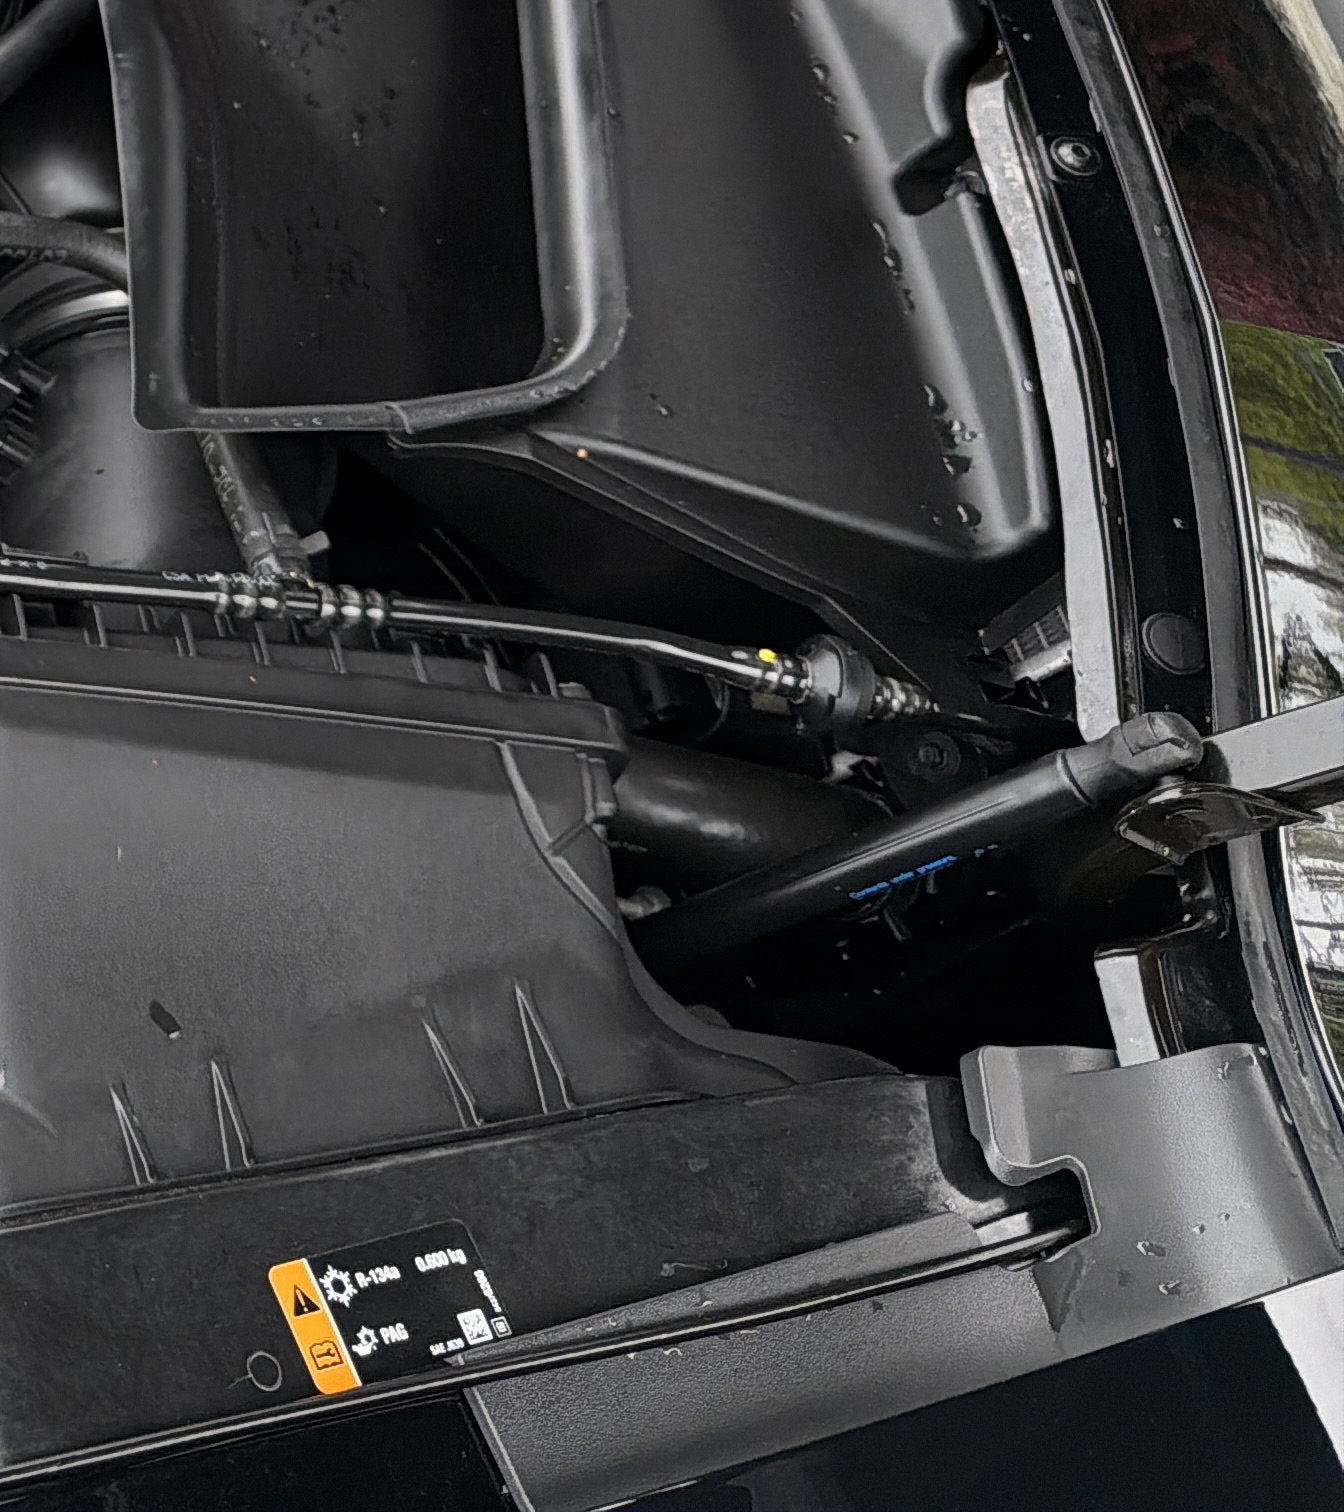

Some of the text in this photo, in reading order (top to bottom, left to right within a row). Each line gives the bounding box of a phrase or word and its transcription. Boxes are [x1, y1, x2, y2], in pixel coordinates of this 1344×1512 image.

[354, 1248, 468, 1289] R-134a 0.600 kg
[379, 1323, 410, 1345] PAG
